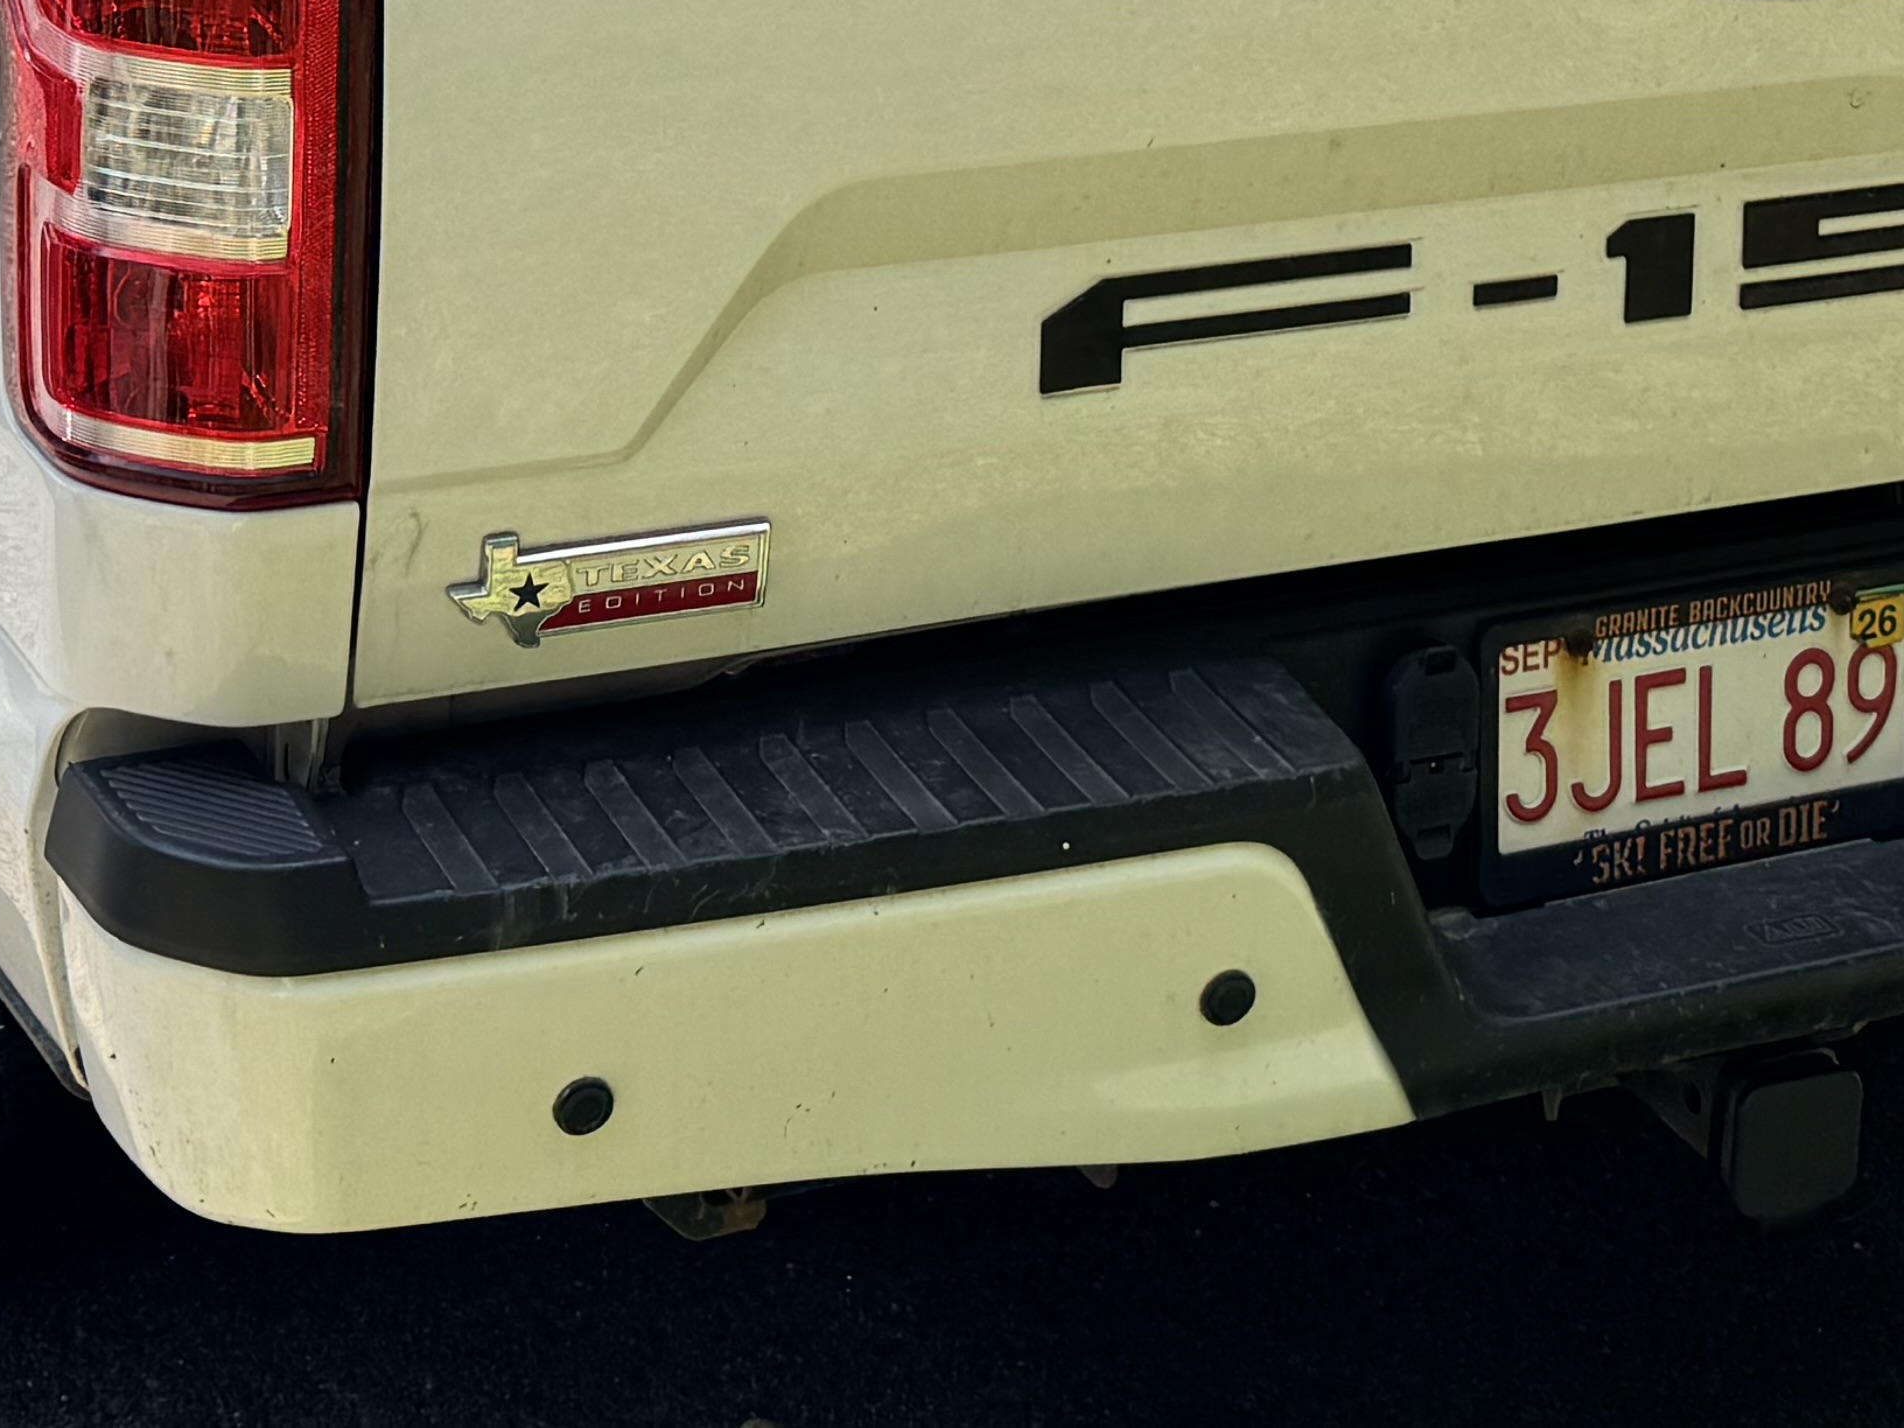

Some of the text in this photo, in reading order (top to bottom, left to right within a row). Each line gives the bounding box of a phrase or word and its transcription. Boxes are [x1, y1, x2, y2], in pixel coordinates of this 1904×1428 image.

[576, 544, 751, 587] TEXAS
[577, 577, 746, 614] EDITION
[1596, 580, 1832, 638] GRANITE BACKCOUNTRY
[1857, 603, 1897, 641] 26
[1500, 639, 1560, 677] SEP
[1504, 644, 1897, 823] 3JEL 89
[1659, 818, 1734, 872] FREE
[1739, 816, 1771, 850] OR
